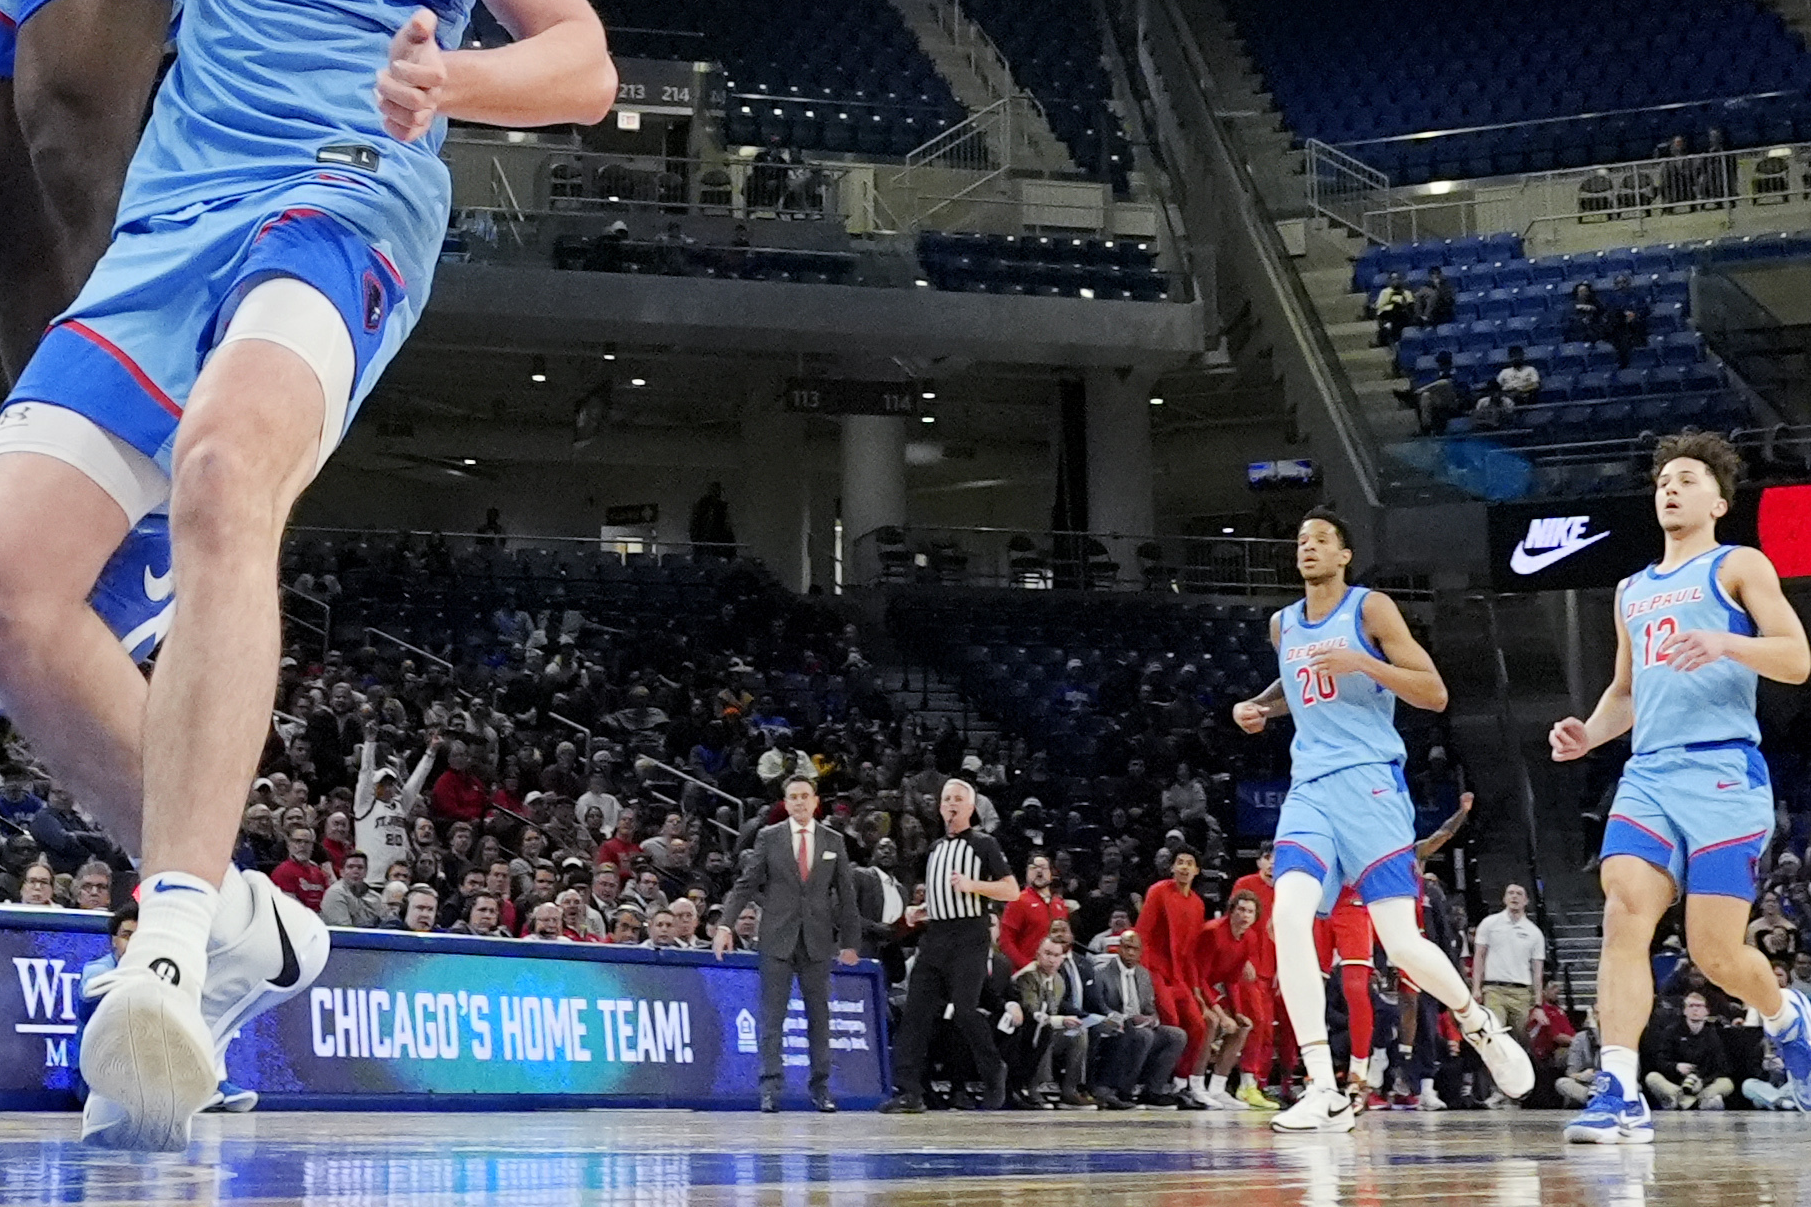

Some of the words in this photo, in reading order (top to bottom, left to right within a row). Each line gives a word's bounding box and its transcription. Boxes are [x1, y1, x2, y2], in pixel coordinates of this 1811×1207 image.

[618, 83, 645, 100] 213
[661, 86, 690, 102] 214
[793, 391, 819, 408] 113
[884, 394, 910, 411] 114
[1524, 516, 1590, 549] NIKE
[1643, 614, 1679, 670] 12
[1296, 665, 1338, 708] 20
[310, 987, 493, 1061] CHICAGO'S
[500, 995, 591, 1062] HOME
[597, 998, 694, 1064] TEAM!
